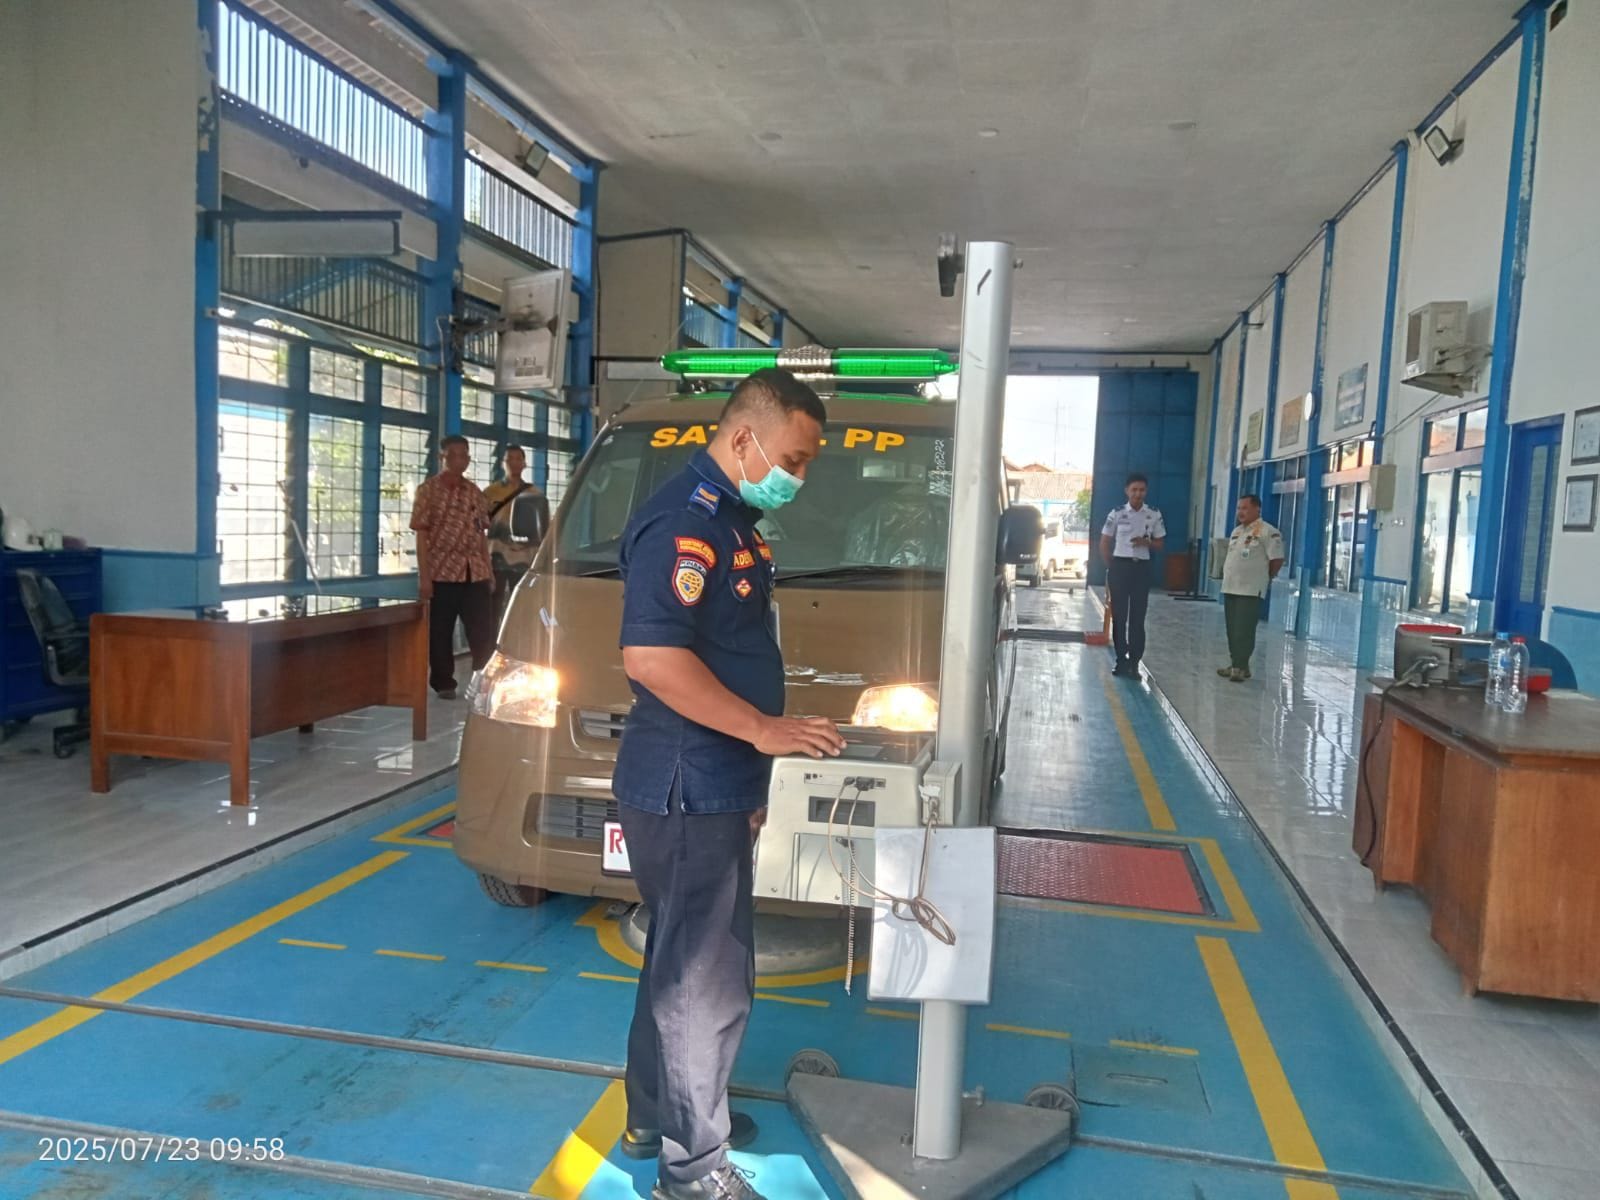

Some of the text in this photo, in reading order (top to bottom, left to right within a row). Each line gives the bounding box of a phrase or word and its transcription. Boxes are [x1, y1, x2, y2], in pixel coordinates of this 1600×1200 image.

[650, 424, 905, 452] SA PP
[609, 828, 624, 854] R
